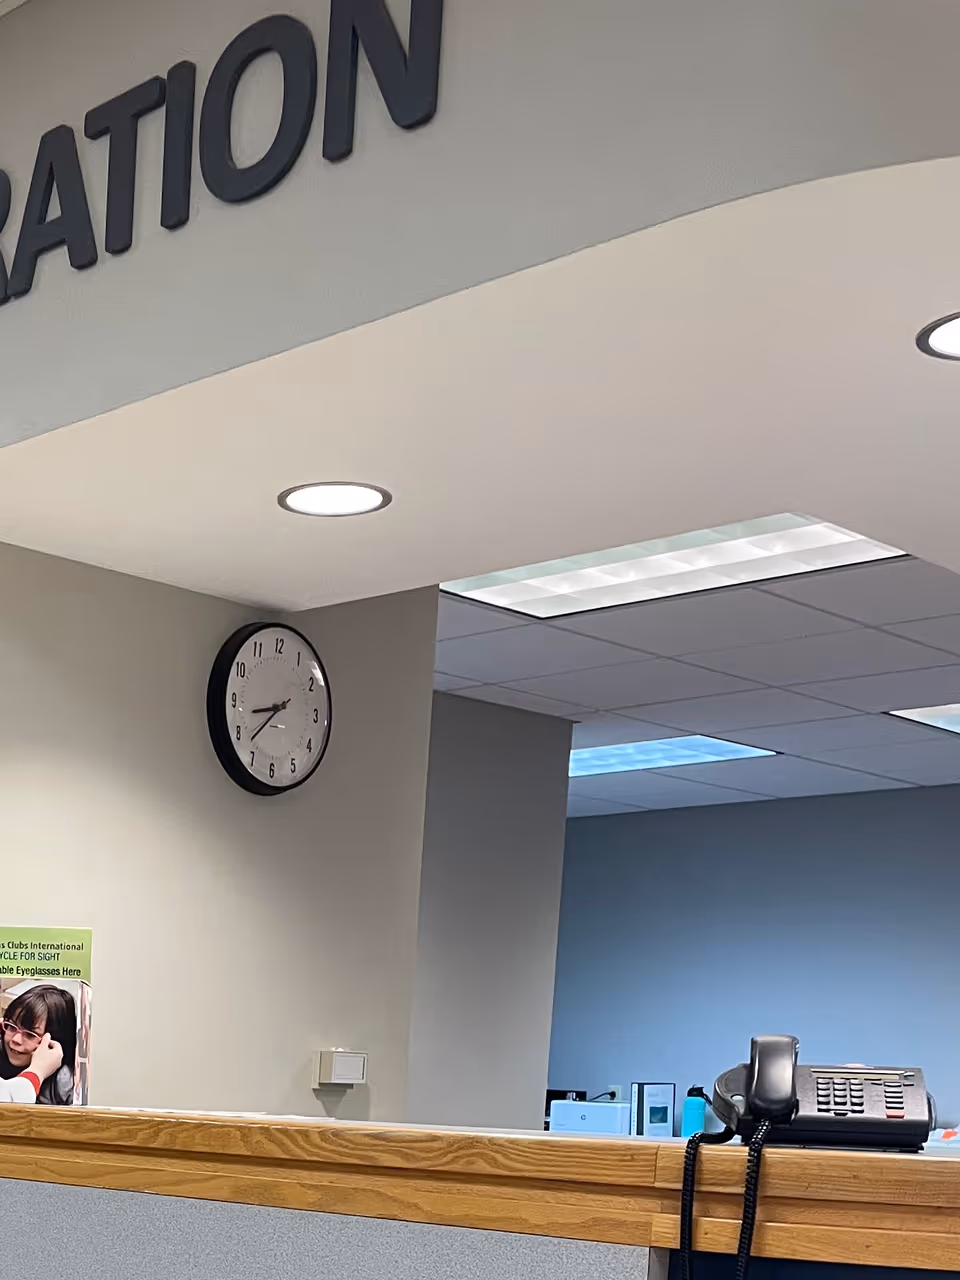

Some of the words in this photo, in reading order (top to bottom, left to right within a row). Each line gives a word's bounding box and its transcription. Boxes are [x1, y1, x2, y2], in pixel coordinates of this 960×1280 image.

[253, 641, 262, 658] 11
[275, 638, 284, 654] 12
[296, 651, 301, 667] 1
[236, 661, 246, 678] 10
[308, 676, 314, 692] 2
[231, 692, 237, 708] 9
[313, 708, 319, 724] 3
[235, 725, 241, 741] 8
[306, 738, 313, 753] 4
[250, 751, 256, 767] 7
[290, 757, 296, 773] 5
[268, 762, 275, 779] 6
[7, 940, 29, 950] Clubs
[30, 941, 84, 951] International
[20, 951, 36, 961] FOR
[38, 952, 60, 961] SIGHT
[16, 966, 60, 977] Eyeglasses
[62, 967, 82, 976] Here
